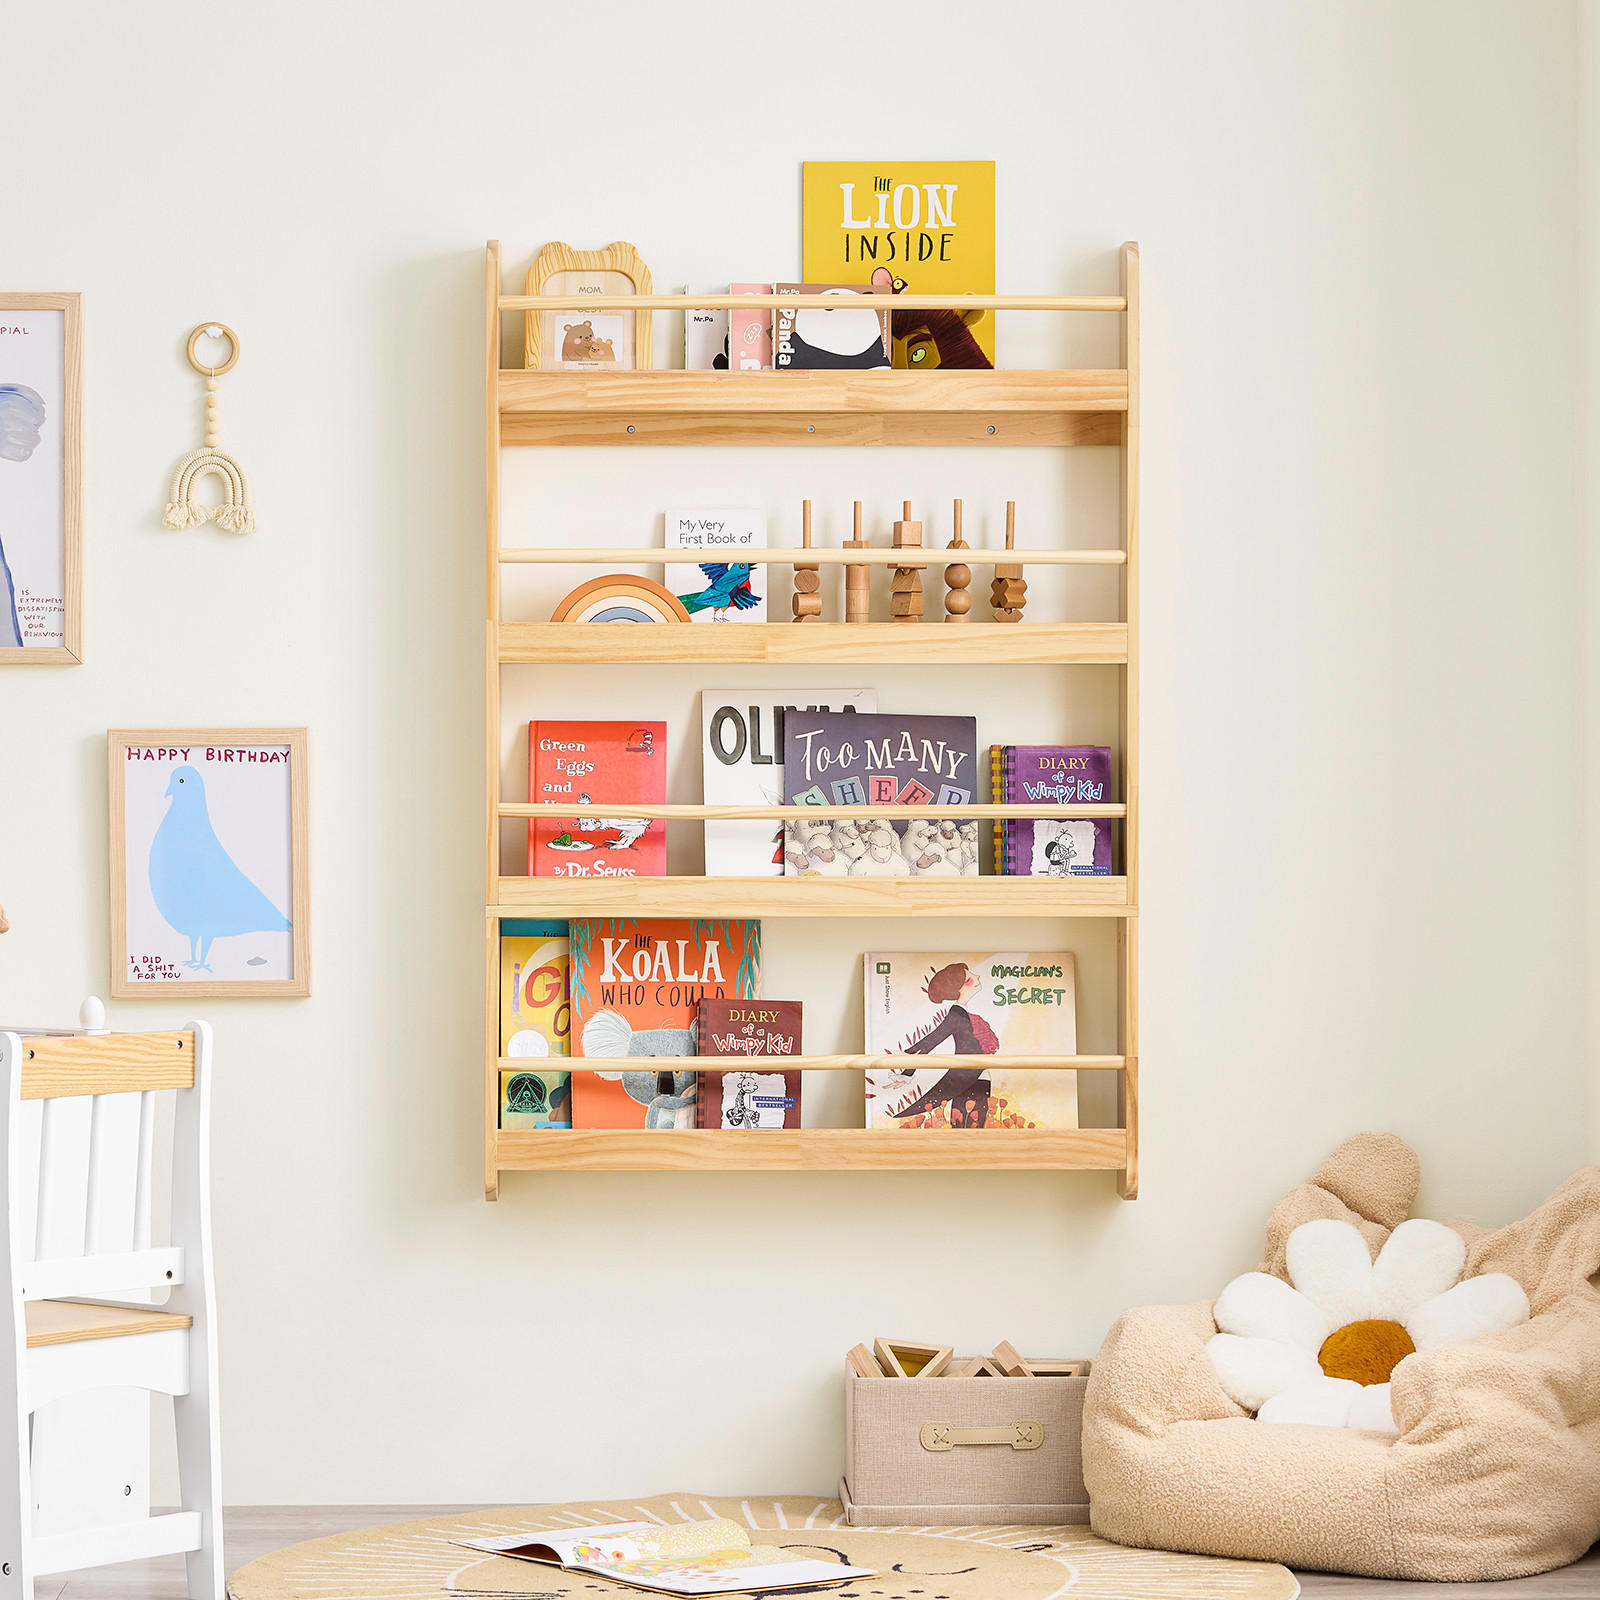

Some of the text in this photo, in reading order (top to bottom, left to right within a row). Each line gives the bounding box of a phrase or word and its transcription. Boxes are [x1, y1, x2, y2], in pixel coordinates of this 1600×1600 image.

[874, 176, 893, 191] THE
[845, 231, 954, 262] INSIDE
[680, 519, 724, 532] My Very
[680, 532, 752, 544] First Book of
[539, 738, 586, 752] Green
[127, 747, 290, 763] HAPPY BIRTHDAY
[795, 729, 968, 781] Too MANY
[556, 758, 594, 777] Eggs
[1039, 757, 1089, 770] DIARY
[1051, 771, 1075, 783] of a
[543, 781, 572, 793] and
[1023, 780, 1103, 804] Wimpy Kid
[554, 867, 566, 876] By
[634, 933, 652, 949] THE
[130, 955, 162, 964] I DID
[133, 964, 174, 973] A SHIT
[991, 965, 1063, 978] MAGICIAN'S
[601, 984, 645, 1006] WHO
[993, 985, 1066, 1006] SECRET
[729, 1009, 780, 1023] DIARY
[742, 1023, 765, 1036] of a
[712, 1033, 793, 1056] Wimpy Kid
